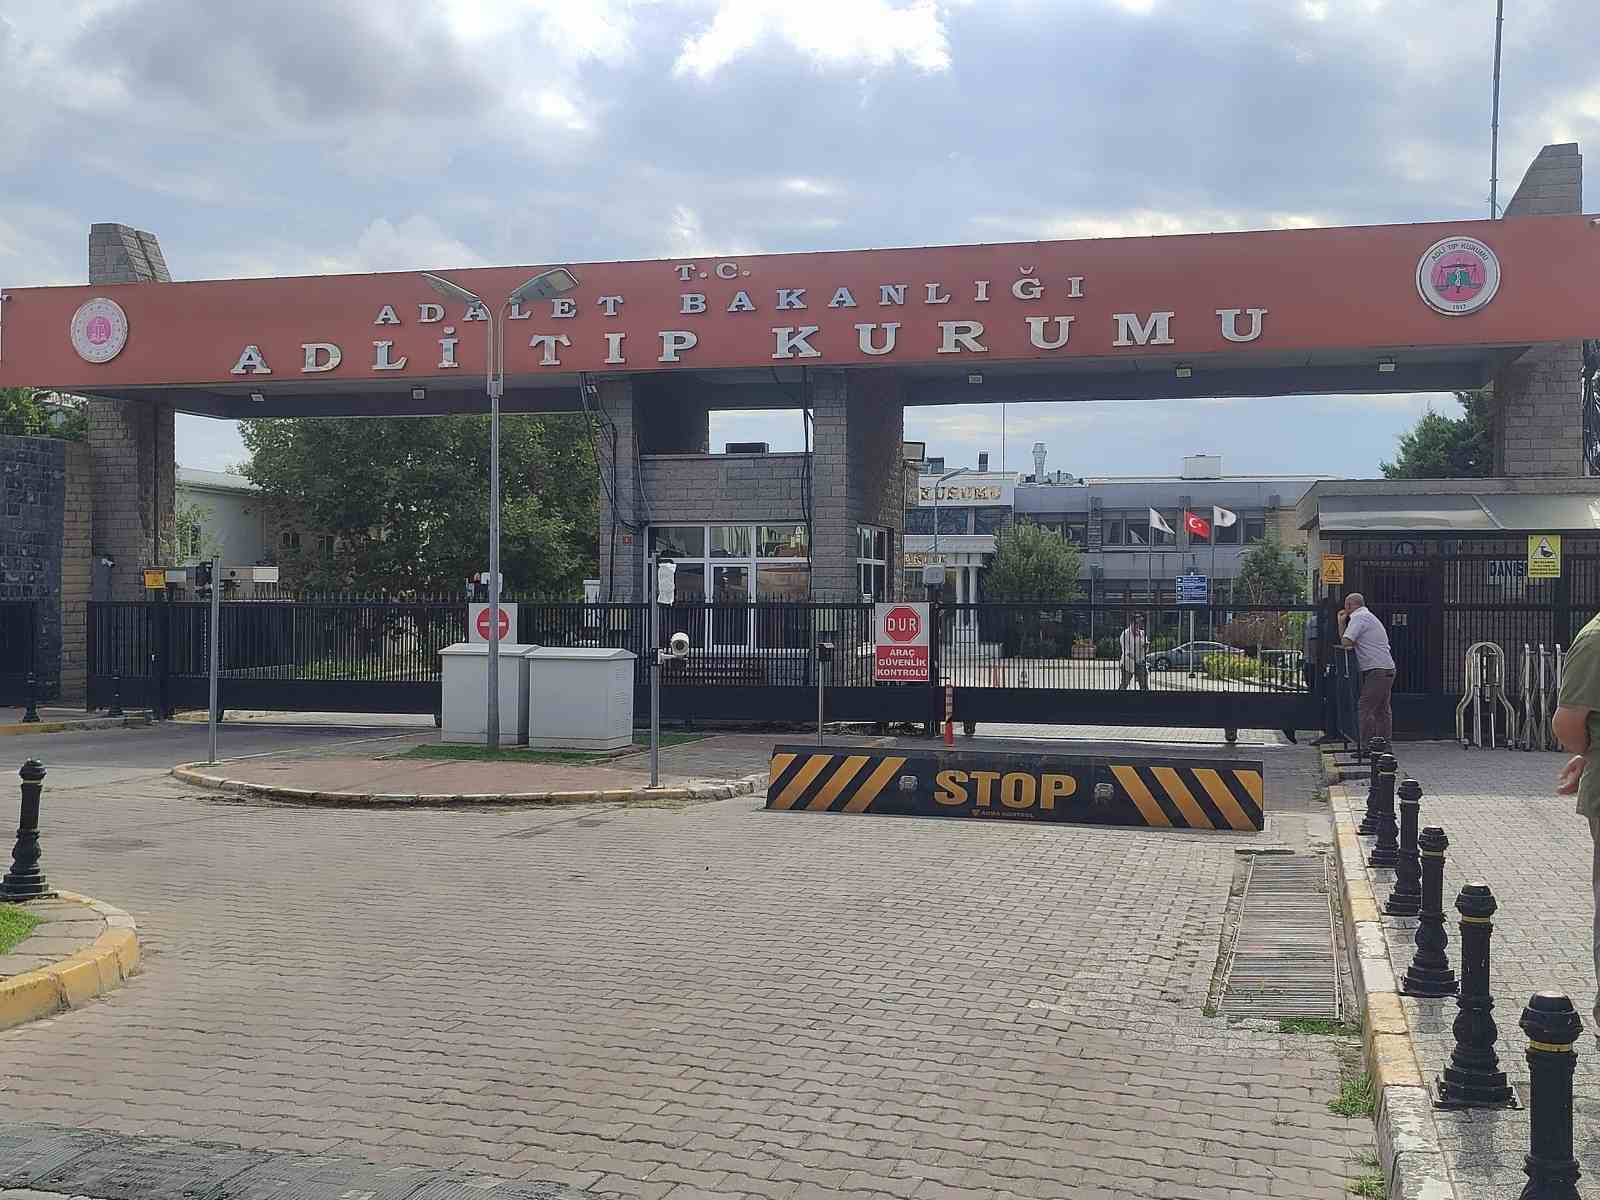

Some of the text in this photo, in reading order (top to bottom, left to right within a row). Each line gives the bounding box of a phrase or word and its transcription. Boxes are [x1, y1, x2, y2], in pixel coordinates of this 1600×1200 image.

[674, 262, 751, 282] T.C.
[373, 265, 1085, 325] ADALET BAKANLIĞI
[229, 307, 1269, 375] ADLİ TIP KURUMU
[887, 617, 917, 632] DUR
[878, 657, 928, 667] GÜVENLİK
[889, 648, 915, 658] ARAÇ
[934, 769, 1077, 810] STOP
